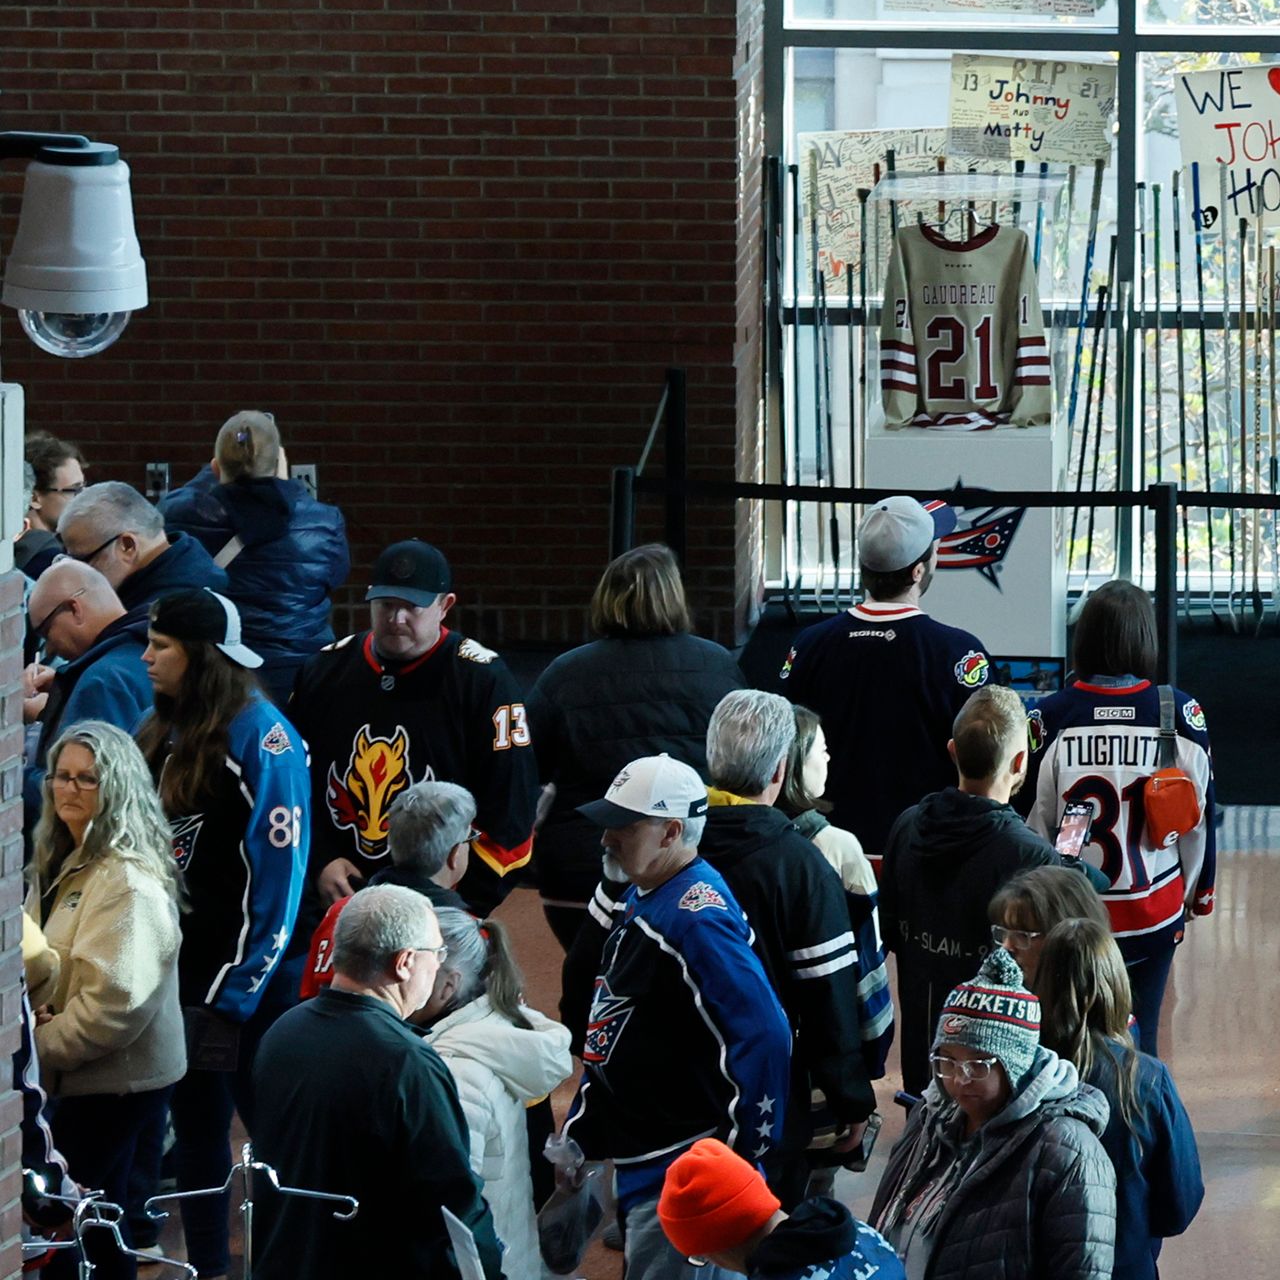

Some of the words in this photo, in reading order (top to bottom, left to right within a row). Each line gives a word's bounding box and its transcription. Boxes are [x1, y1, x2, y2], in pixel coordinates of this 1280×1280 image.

[962, 73, 979, 92] 13
[1080, 82, 1099, 99] 21
[989, 79, 1071, 120] Johnny
[1182, 70, 1252, 114] WE
[922, 284, 996, 305] GAUDREAU
[925, 314, 1000, 402] 21
[492, 704, 532, 751] 13
[1094, 707, 1135, 720] CCM
[1062, 775, 1151, 893] 31
[921, 931, 961, 958] SLAM
[950, 990, 1026, 1019] JACKETS
